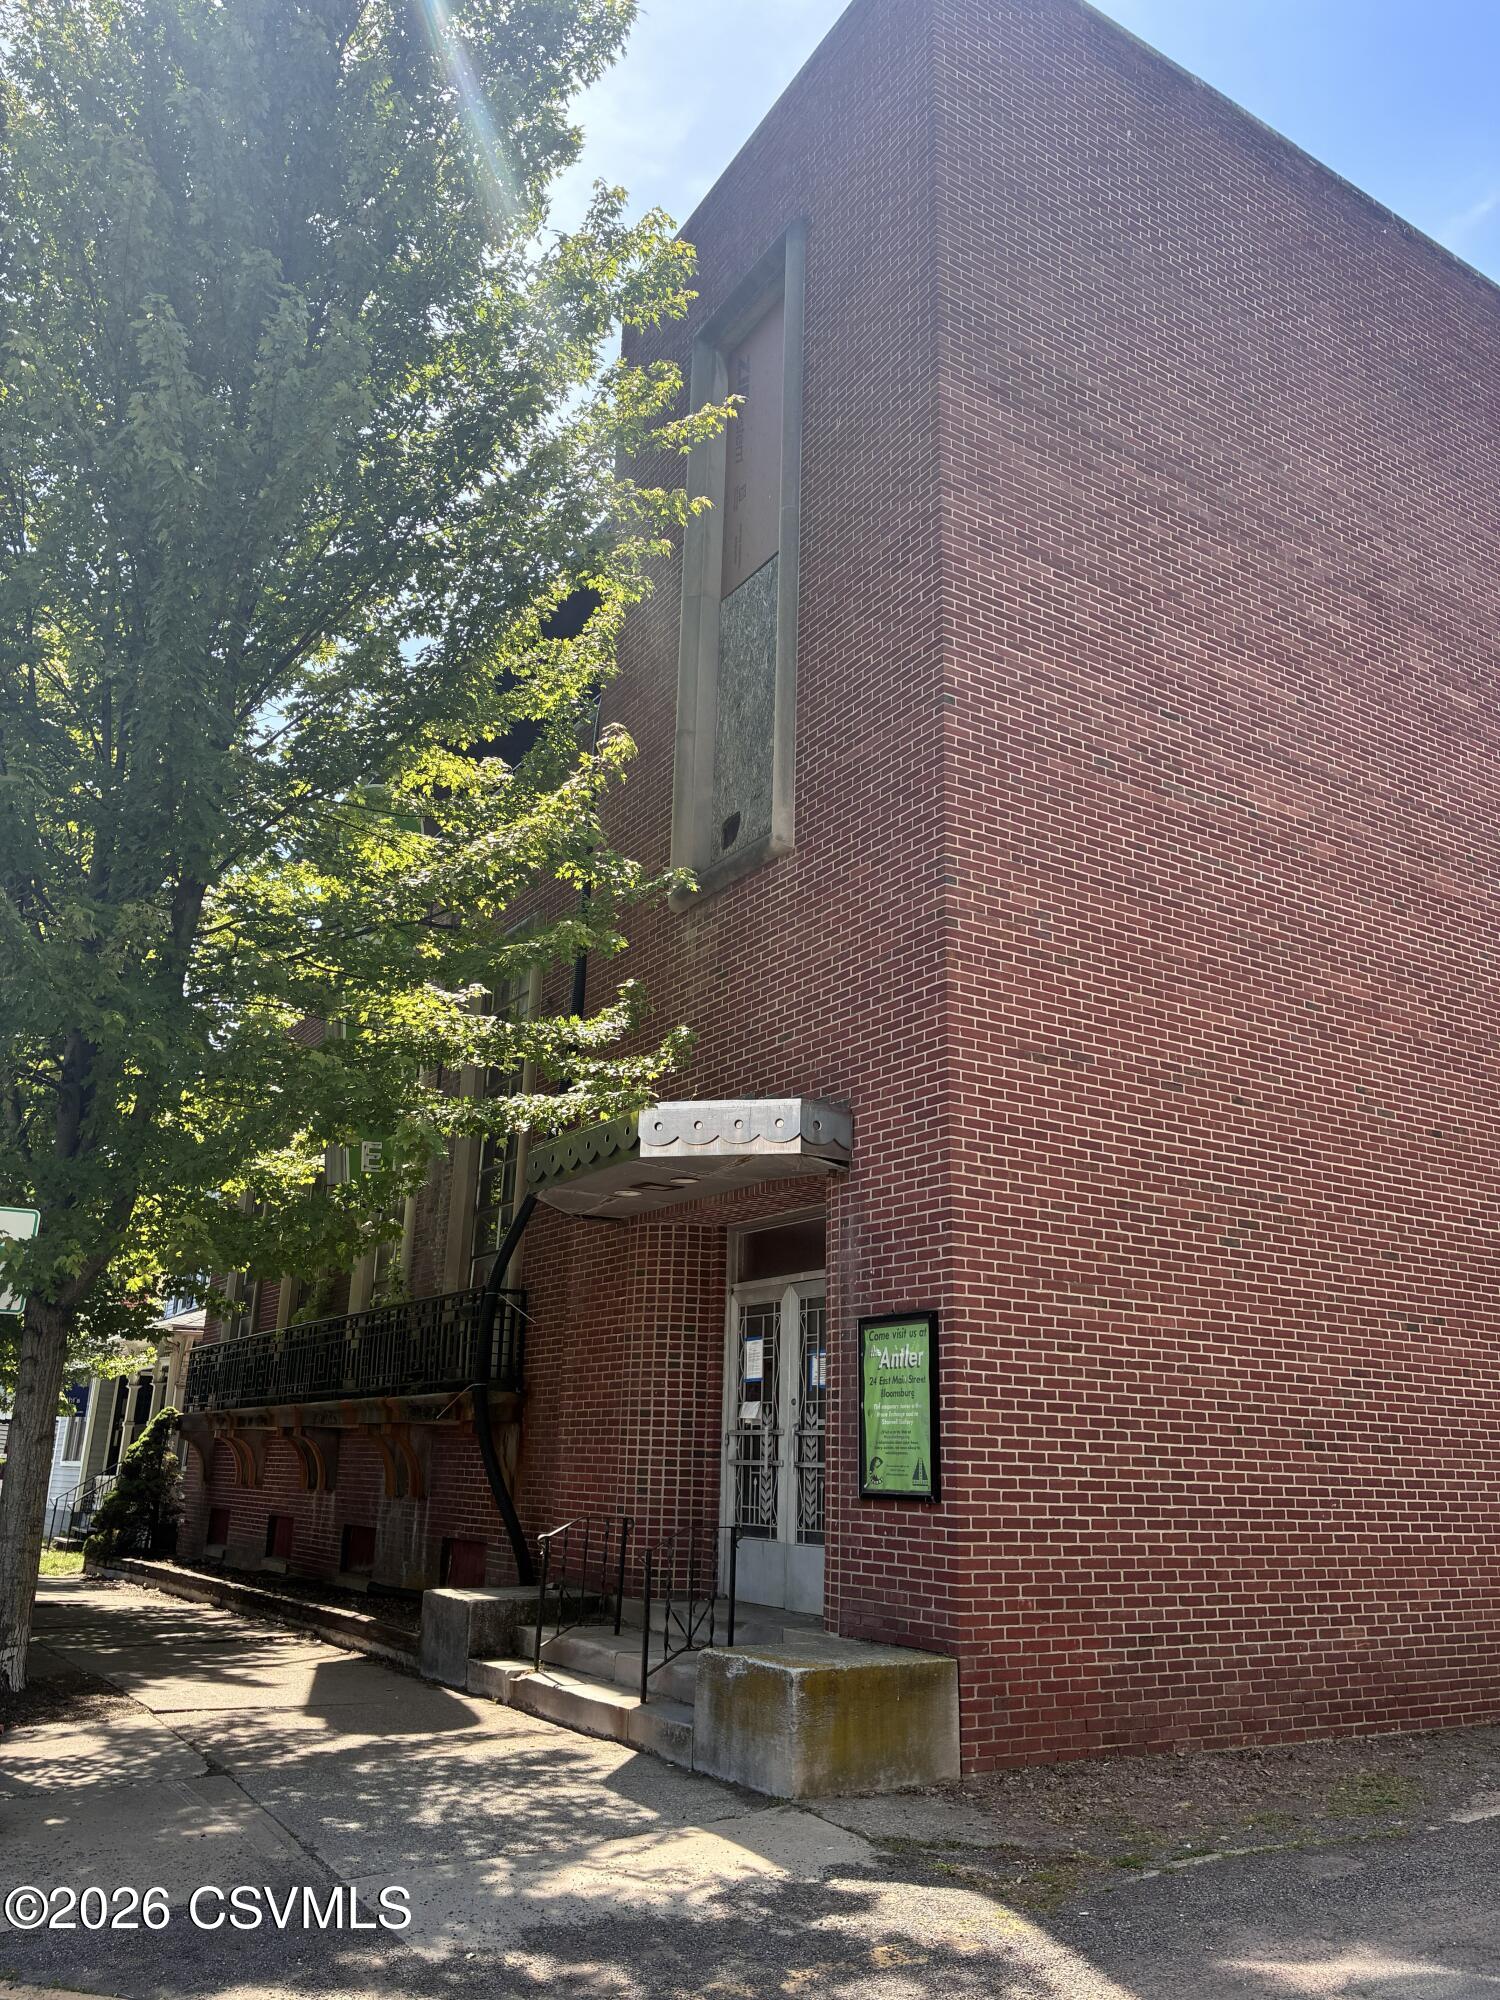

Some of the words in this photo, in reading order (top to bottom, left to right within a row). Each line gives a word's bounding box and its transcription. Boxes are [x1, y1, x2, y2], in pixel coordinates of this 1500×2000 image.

[869, 1330, 889, 1341] Come
[892, 1328, 907, 1339] visit
[909, 1329, 917, 1338] us
[919, 1327, 927, 1338] at
[879, 1343, 924, 1369] Antler
[869, 1377, 877, 1386] 24
[879, 1376, 891, 1385] East
[891, 1374, 907, 1384] Main
[908, 1374, 926, 1384] Street
